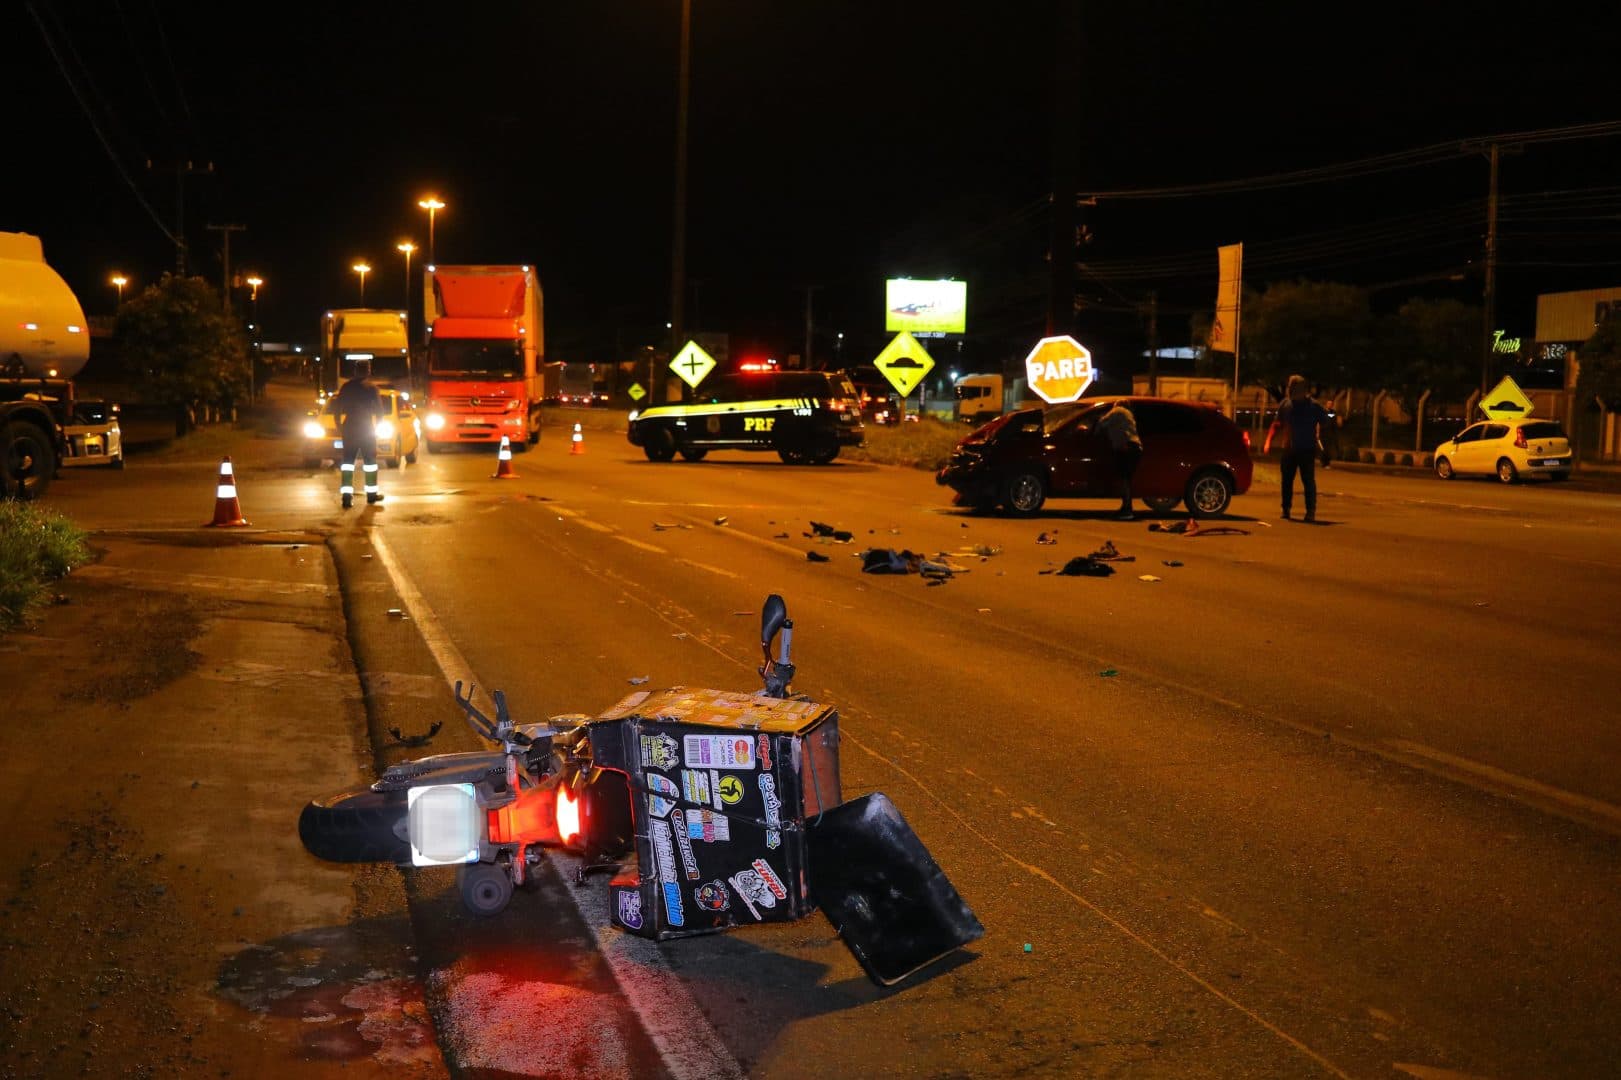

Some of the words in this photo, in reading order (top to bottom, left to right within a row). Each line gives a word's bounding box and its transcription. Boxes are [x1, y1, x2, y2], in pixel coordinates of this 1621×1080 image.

[1029, 357, 1089, 383] PARE
[743, 418, 776, 432] PRF
[753, 861, 785, 899] TURBO
